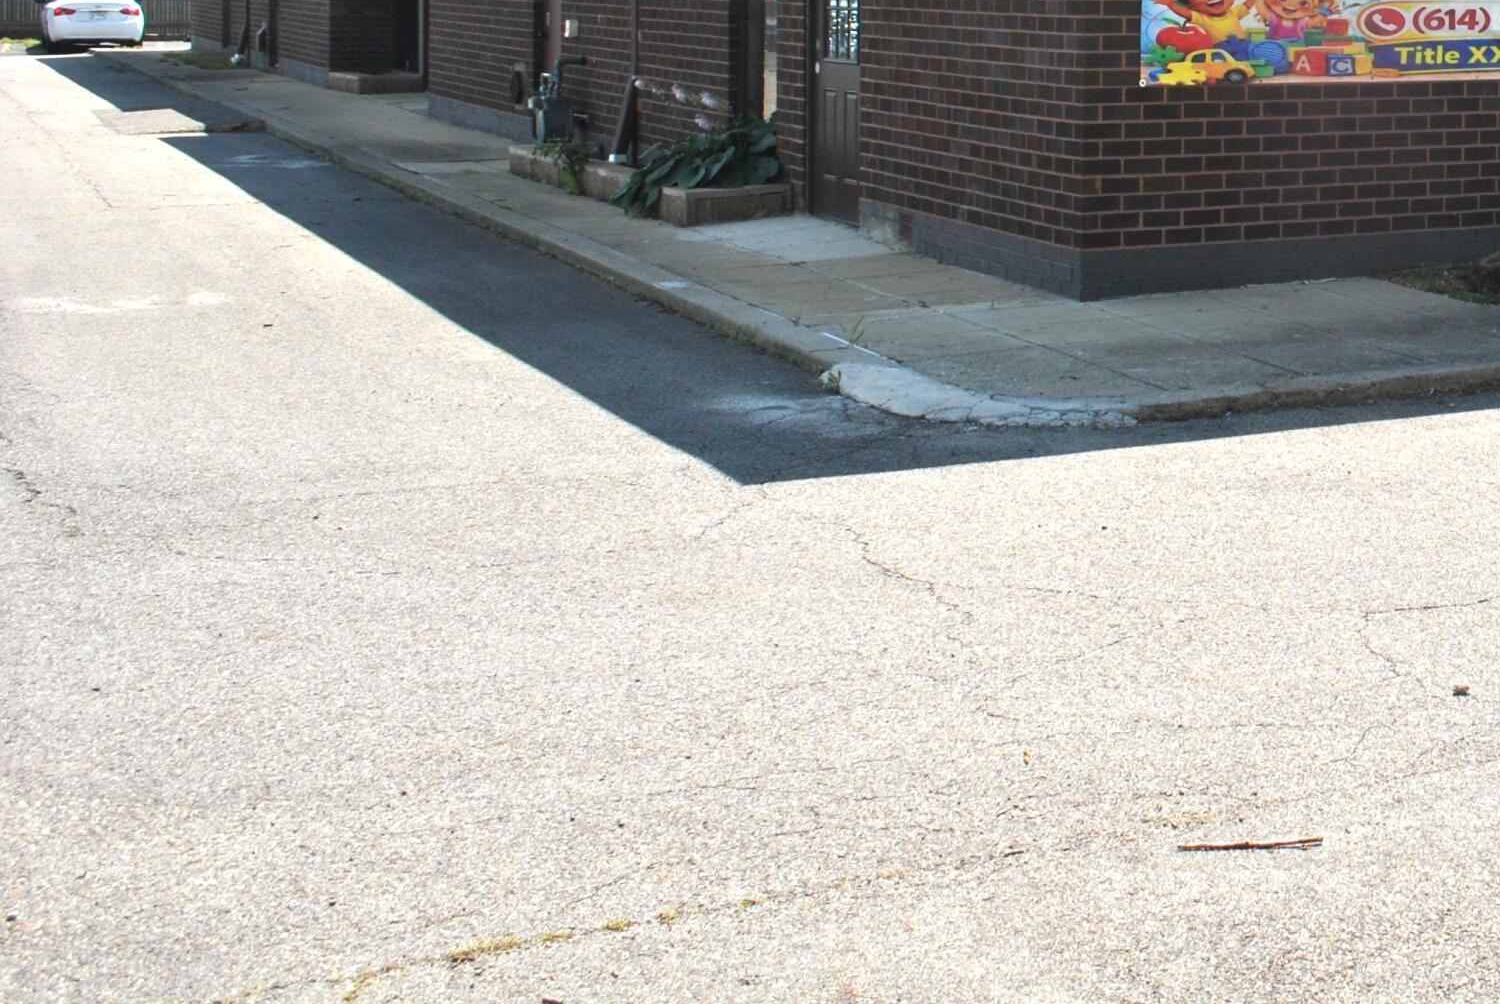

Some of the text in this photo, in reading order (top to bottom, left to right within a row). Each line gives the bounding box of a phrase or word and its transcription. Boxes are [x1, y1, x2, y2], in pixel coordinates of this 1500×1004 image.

[1412, 6, 1491, 34] (614)
[1295, 55, 1311, 72] A
[1393, 44, 1460, 65] Title
